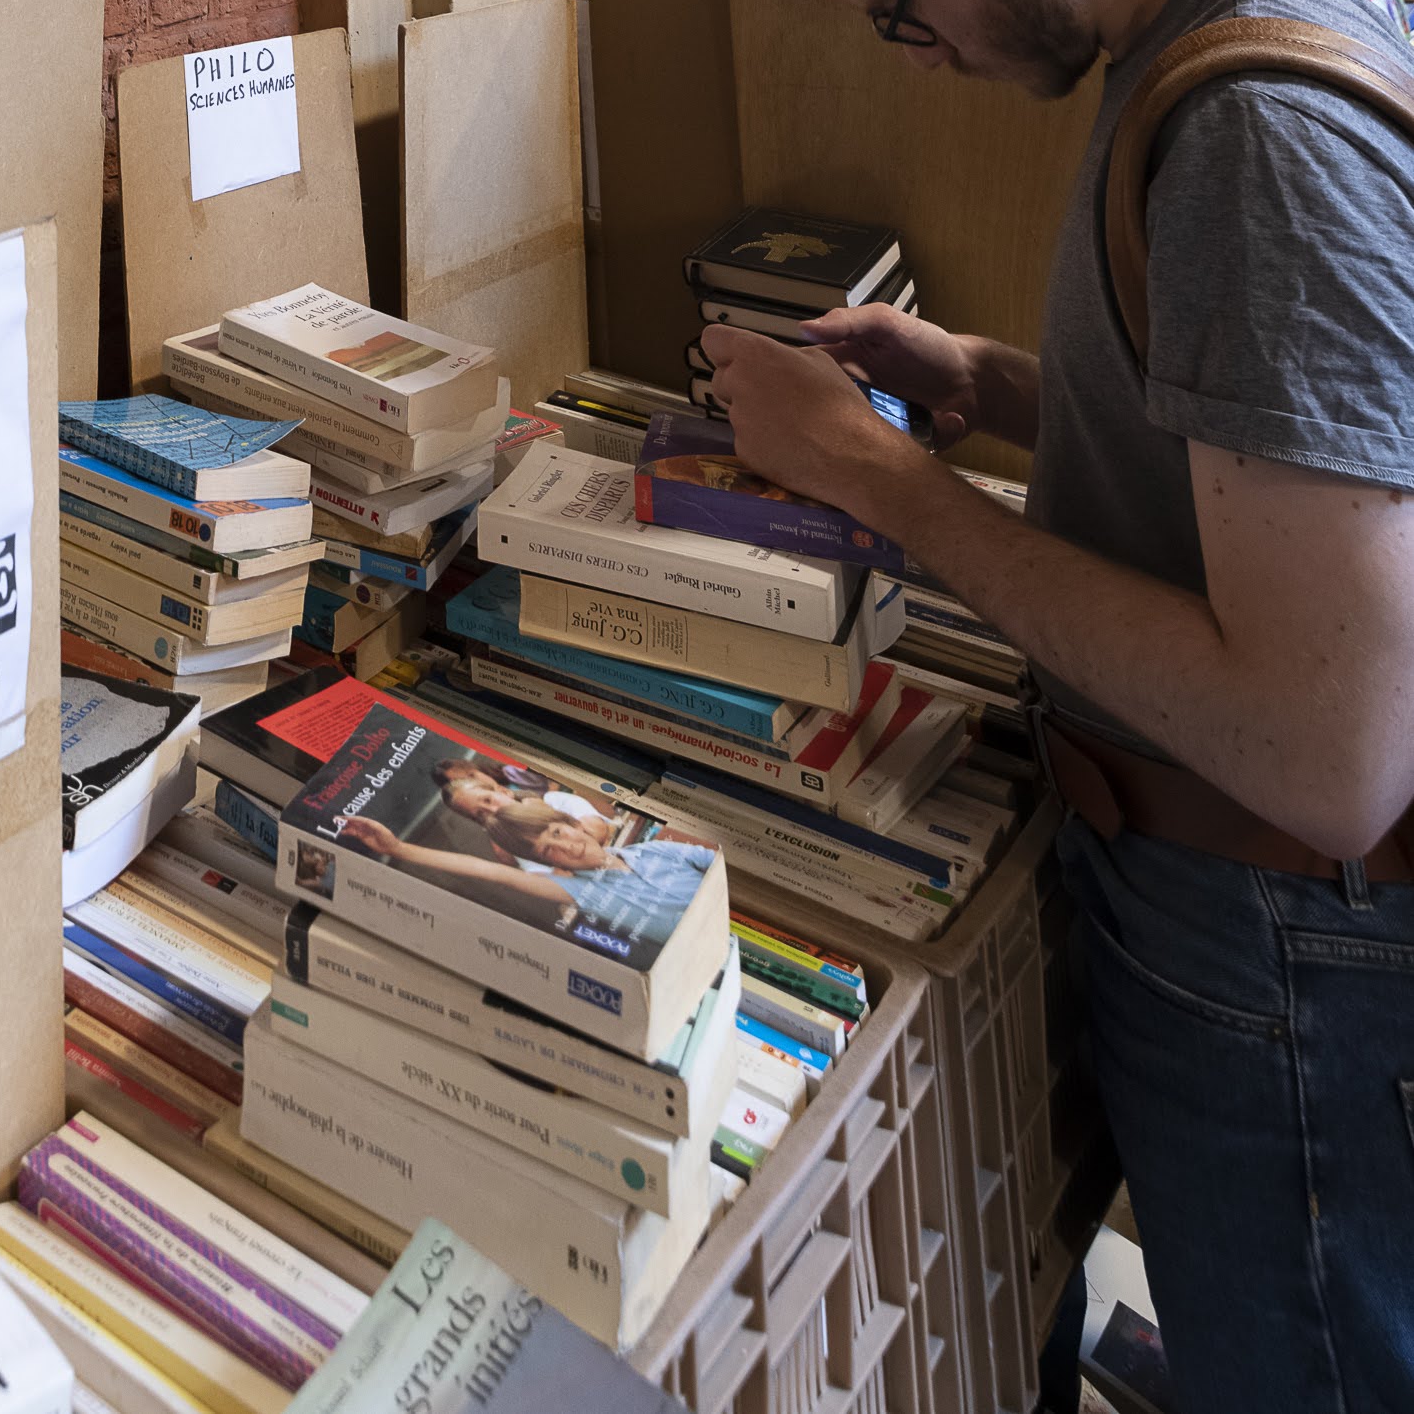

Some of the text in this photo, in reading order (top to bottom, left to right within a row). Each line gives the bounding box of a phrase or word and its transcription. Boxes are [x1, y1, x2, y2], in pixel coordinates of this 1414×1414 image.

[194, 47, 275, 88] PHILO
[190, 73, 295, 111] SCIENCES HUMAINES
[295, 299, 346, 324] La Vérité
[310, 307, 362, 330] de parole
[169, 352, 241, 386] de Boysson-Bardies
[169, 362, 206, 383] Bénédicte
[253, 345, 353, 396] Yves Bonnefoy La Vérité de parole
[242, 385, 382, 447] Comment la parole vient aux enfants
[312, 487, 367, 516] ATTENTION
[560, 469, 610, 520] CES CHERS
[585, 478, 631, 523] DISPARUS
[69, 523, 79, 531] sur
[78, 527, 101, 541] regards
[168, 510, 200, 534] 10 18
[799, 528, 808, 537] de
[800, 517, 841, 533] Du pouvoir
[108, 540, 128, 554] valéry
[810, 530, 842, 544] Bertrand
[127, 549, 141, 560] paul
[528, 541, 649, 578] CES CHERS DISPARUS
[664, 571, 741, 599] Gabriel Ringlet
[75, 597, 119, 621] sous l'Ancien
[765, 588, 773, 611] Albin
[774, 587, 782, 615] Michel
[62, 603, 118, 636] L'enfant et la vie
[569, 610, 606, 635] Jung
[607, 622, 644, 645] C.G.
[656, 684, 697, 708] JUNG
[696, 696, 727, 718] C.G.
[551, 689, 782, 779] La sociodynamique: un art de gouverner
[303, 757, 365, 812] Françoise
[361, 726, 390, 763] Dolto
[314, 724, 426, 843] La cause des enfants
[763, 822, 840, 865] L'EXCLUSION
[343, 875, 378, 902] enfants
[376, 891, 394, 908] des
[771, 870, 833, 902] Orient ancien
[474, 933, 507, 959] Dolto
[574, 921, 631, 955] POCKET
[314, 952, 353, 979] VILLES
[503, 943, 554, 980] Françoise
[163, 979, 191, 999] cerveau
[353, 969, 378, 988] DES
[378, 980, 396, 995] ET
[562, 970, 625, 1014] POCKET
[395, 1058, 555, 1145] Pour sortir du siècle
[263, 1085, 419, 1182] Histoire de la philosophie
[203, 1208, 250, 1245] français
[184, 1254, 237, 1296] Histoire
[283, 1262, 303, 1280] Le
[406, 1234, 457, 1315] Les
[395, 1284, 486, 1414] grands
[453, 1287, 544, 1405] initiés
